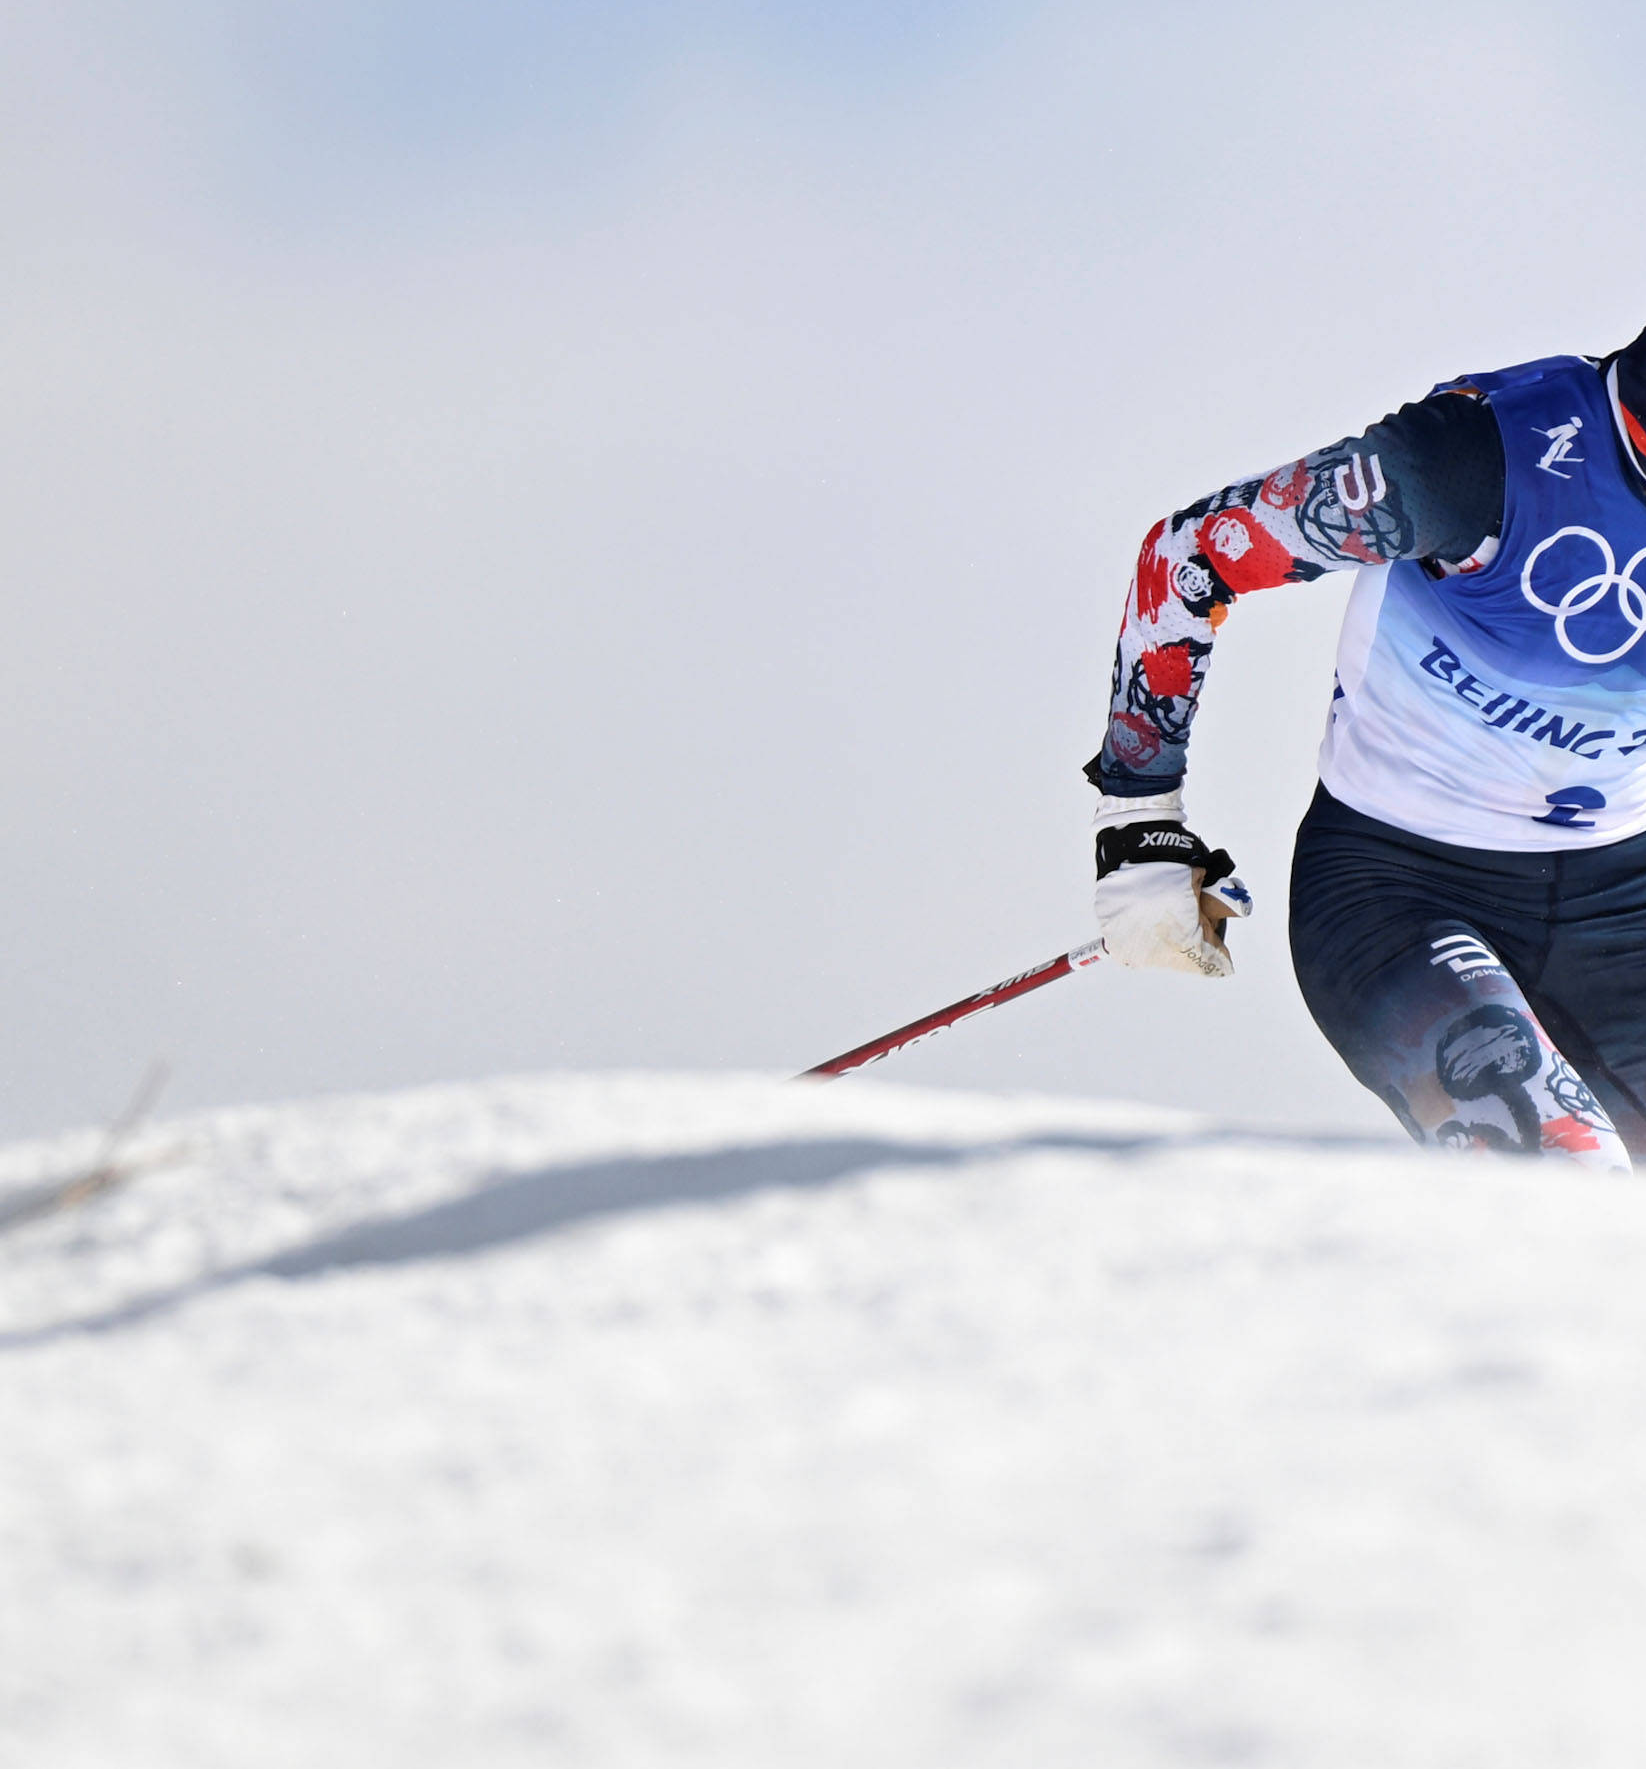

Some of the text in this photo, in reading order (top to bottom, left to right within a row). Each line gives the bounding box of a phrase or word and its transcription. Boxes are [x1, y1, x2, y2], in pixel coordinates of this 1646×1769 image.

[1419, 635, 1616, 760] BEIJING
[1531, 785, 1607, 828] 2
[1138, 831, 1195, 850] SWIX
